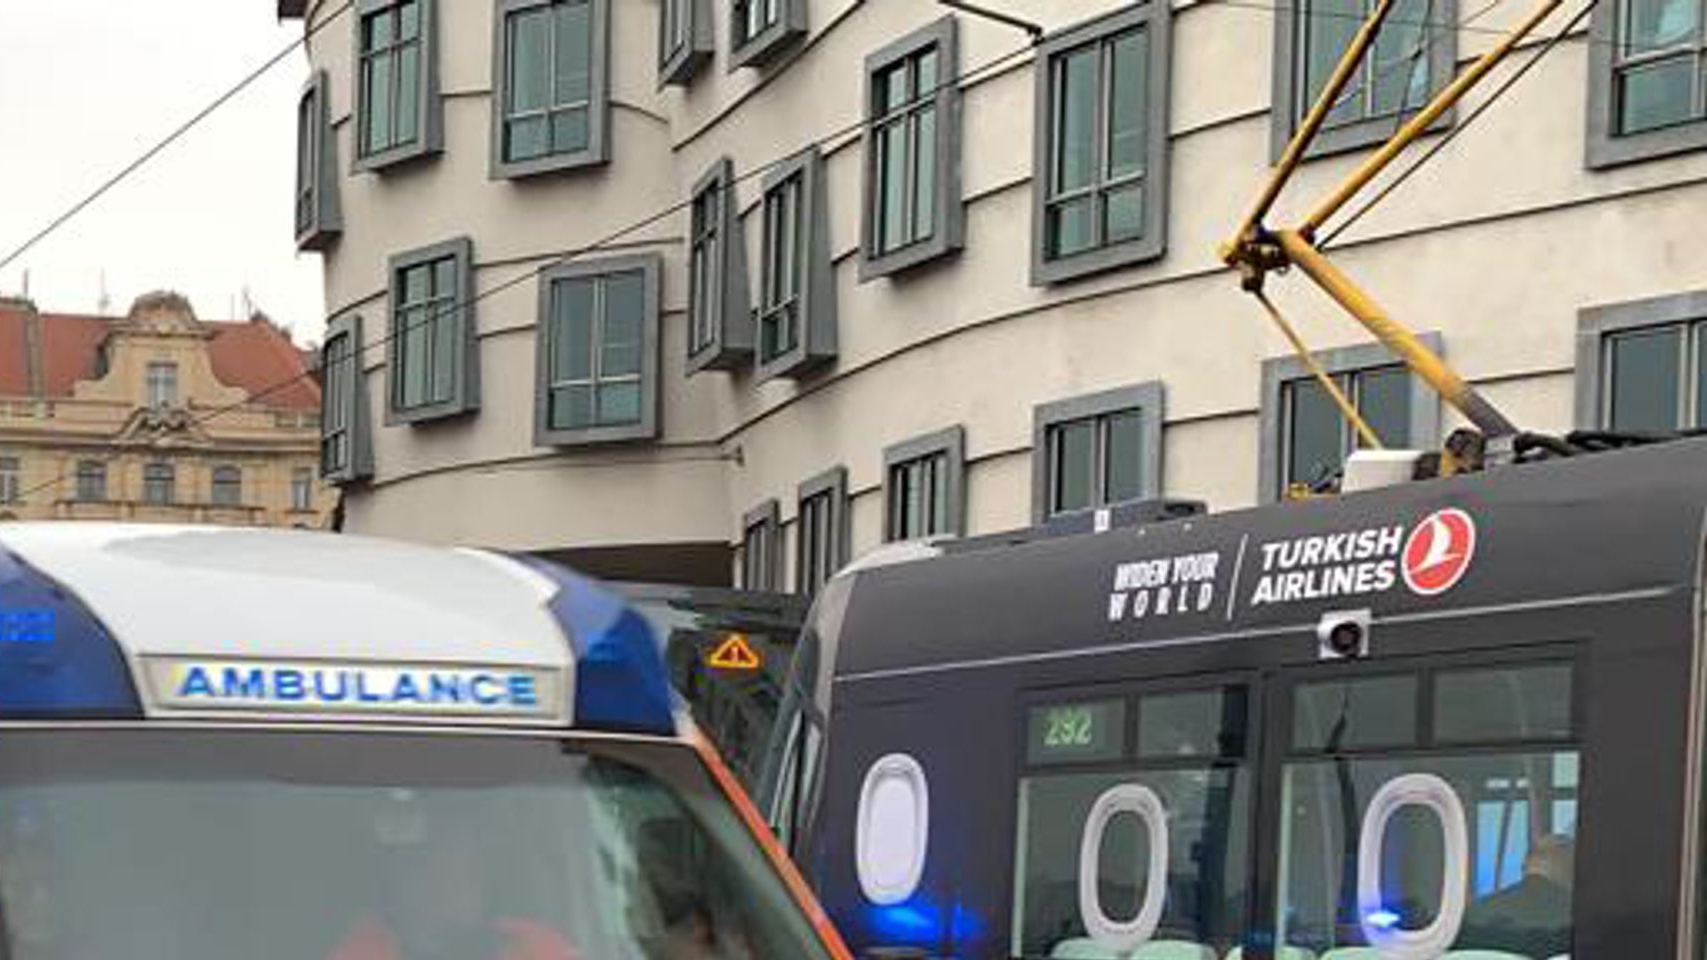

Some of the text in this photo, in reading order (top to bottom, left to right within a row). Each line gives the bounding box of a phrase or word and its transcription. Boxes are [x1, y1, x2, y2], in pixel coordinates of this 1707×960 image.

[1172, 552, 1219, 584] YOUR
[1262, 527, 1404, 571] TURKISH
[1251, 561, 1397, 606] AIRLINES
[180, 667, 538, 706] AMBULANCE
